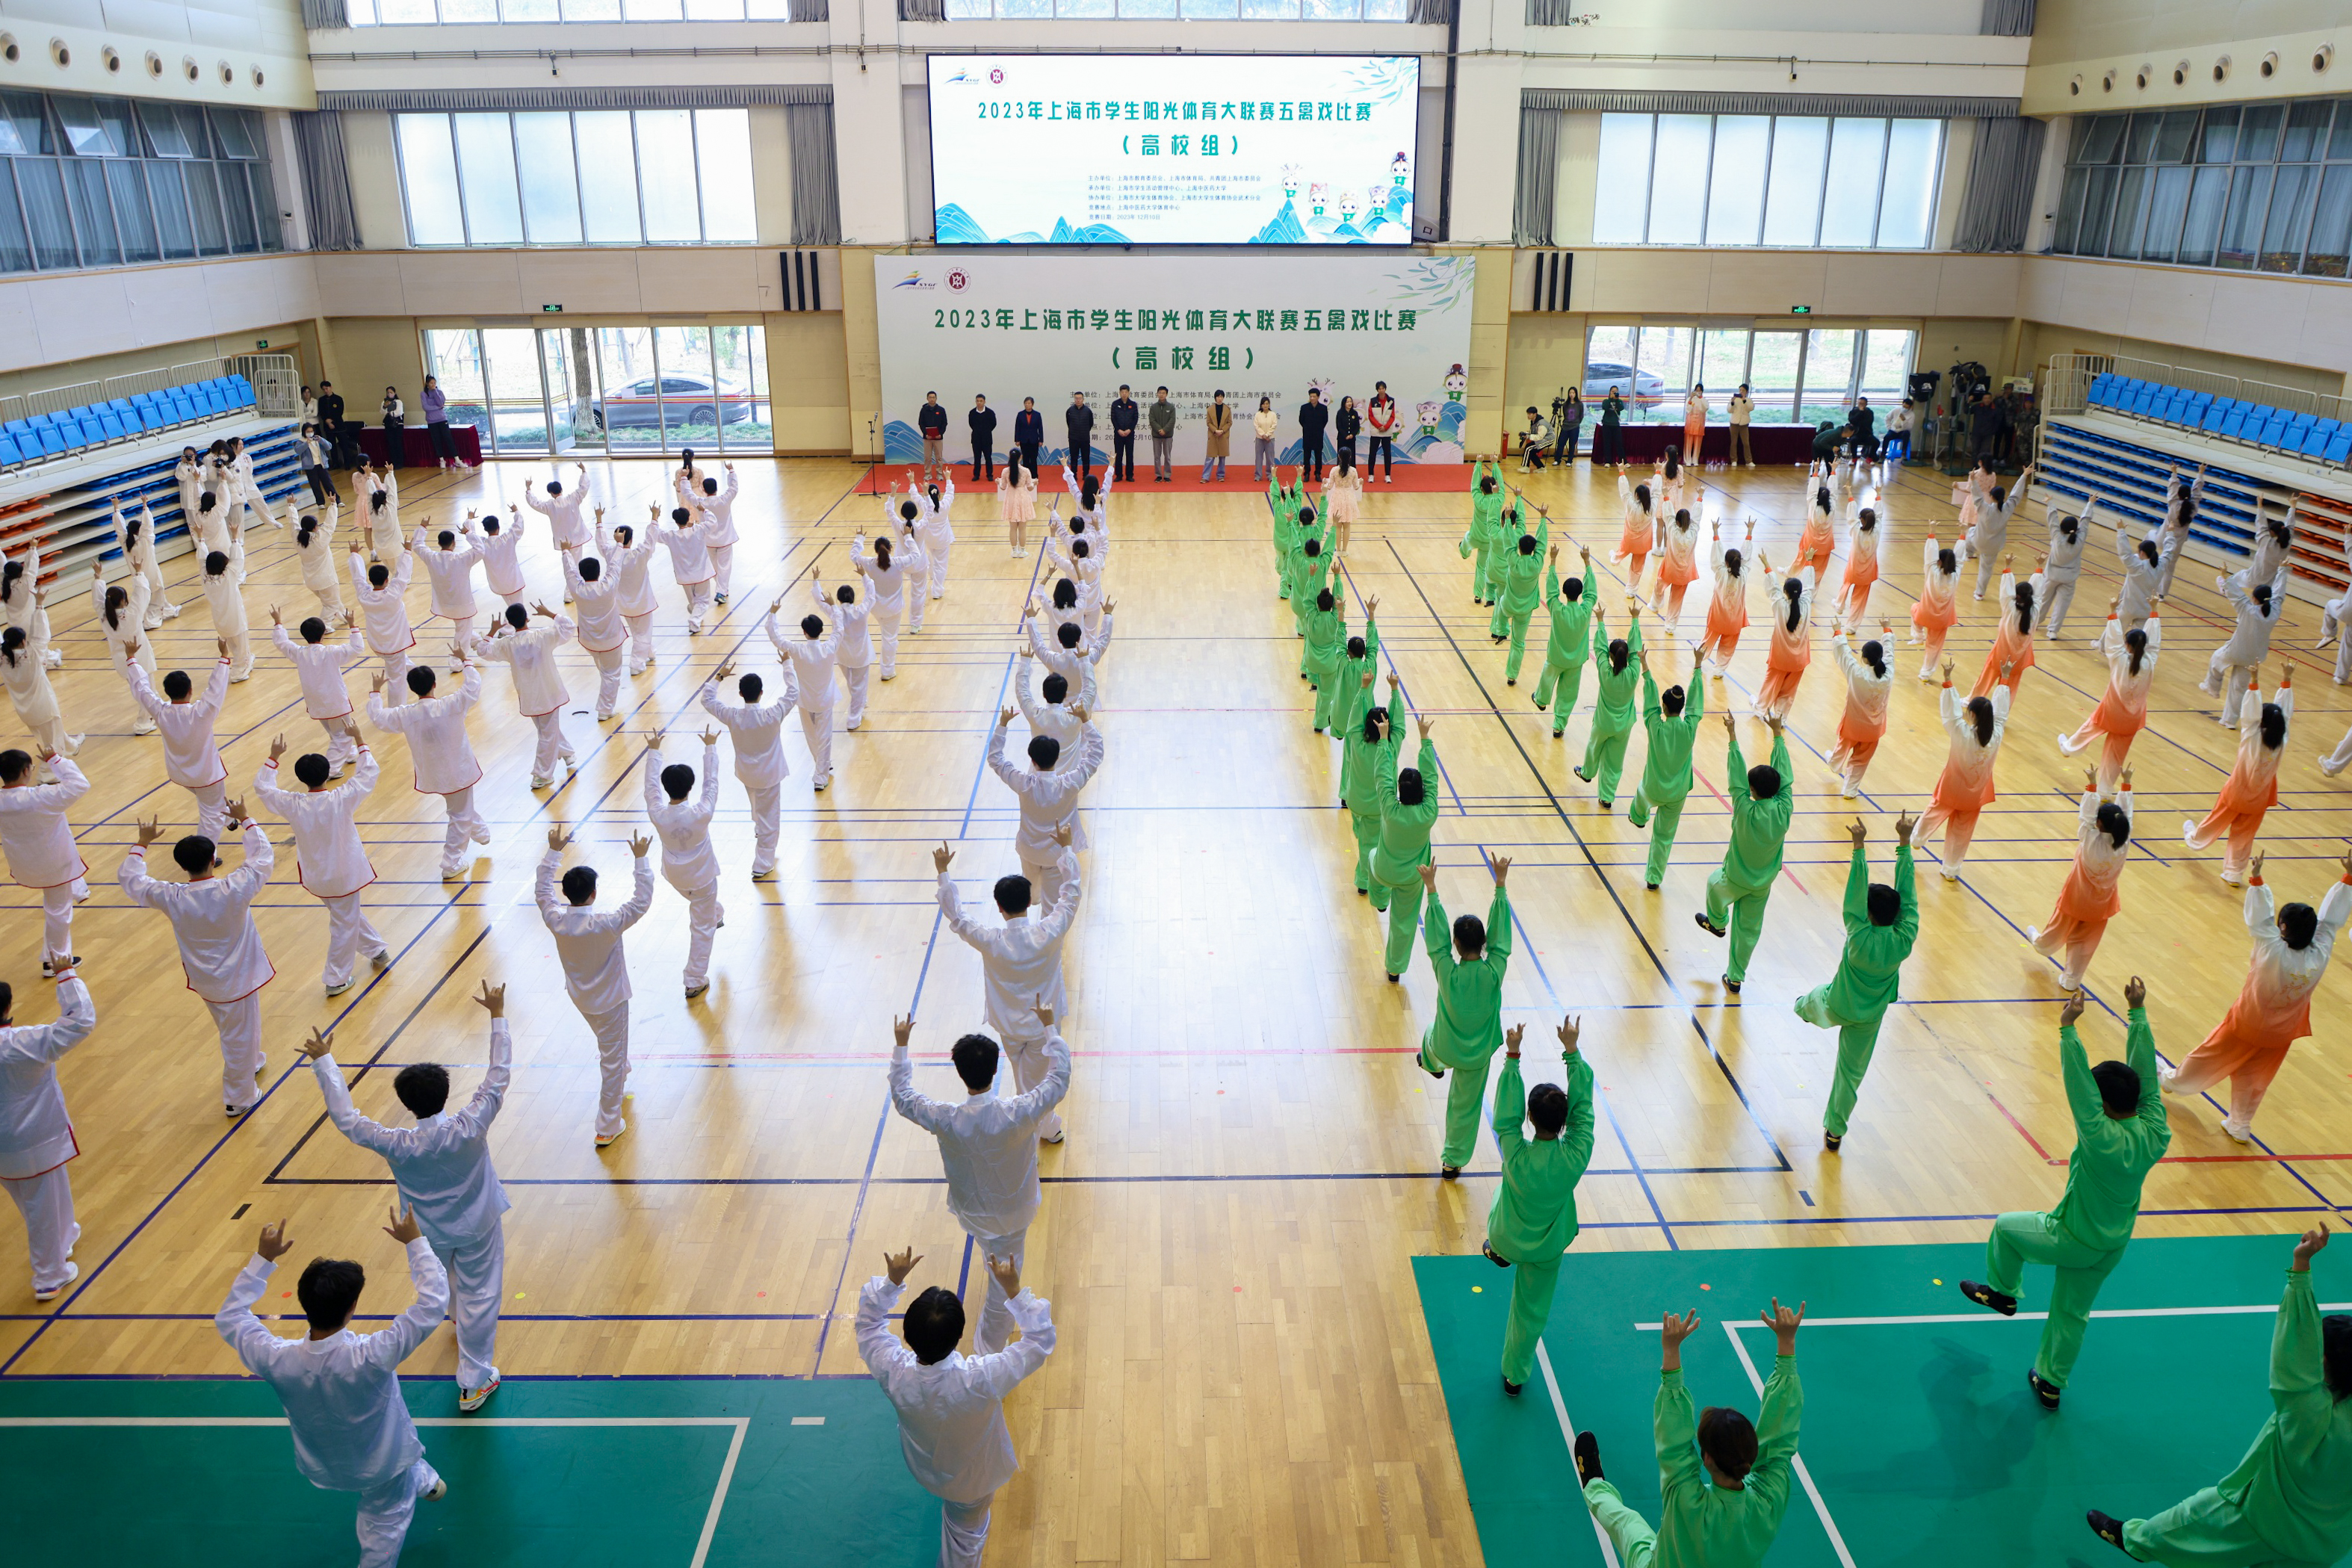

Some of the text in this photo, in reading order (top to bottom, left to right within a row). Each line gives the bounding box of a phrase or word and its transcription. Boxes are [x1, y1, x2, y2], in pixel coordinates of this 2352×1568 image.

[978, 101, 1371, 121] 2023年上海市学生阳光体育大联赛五禽戏比赛
[1123, 134, 1238, 155] （高校组）
[935, 309, 1417, 331] 2023年上海市学生阳光体育大联赛五禽戏比赛
[1112, 346, 1254, 370] （高校组）
